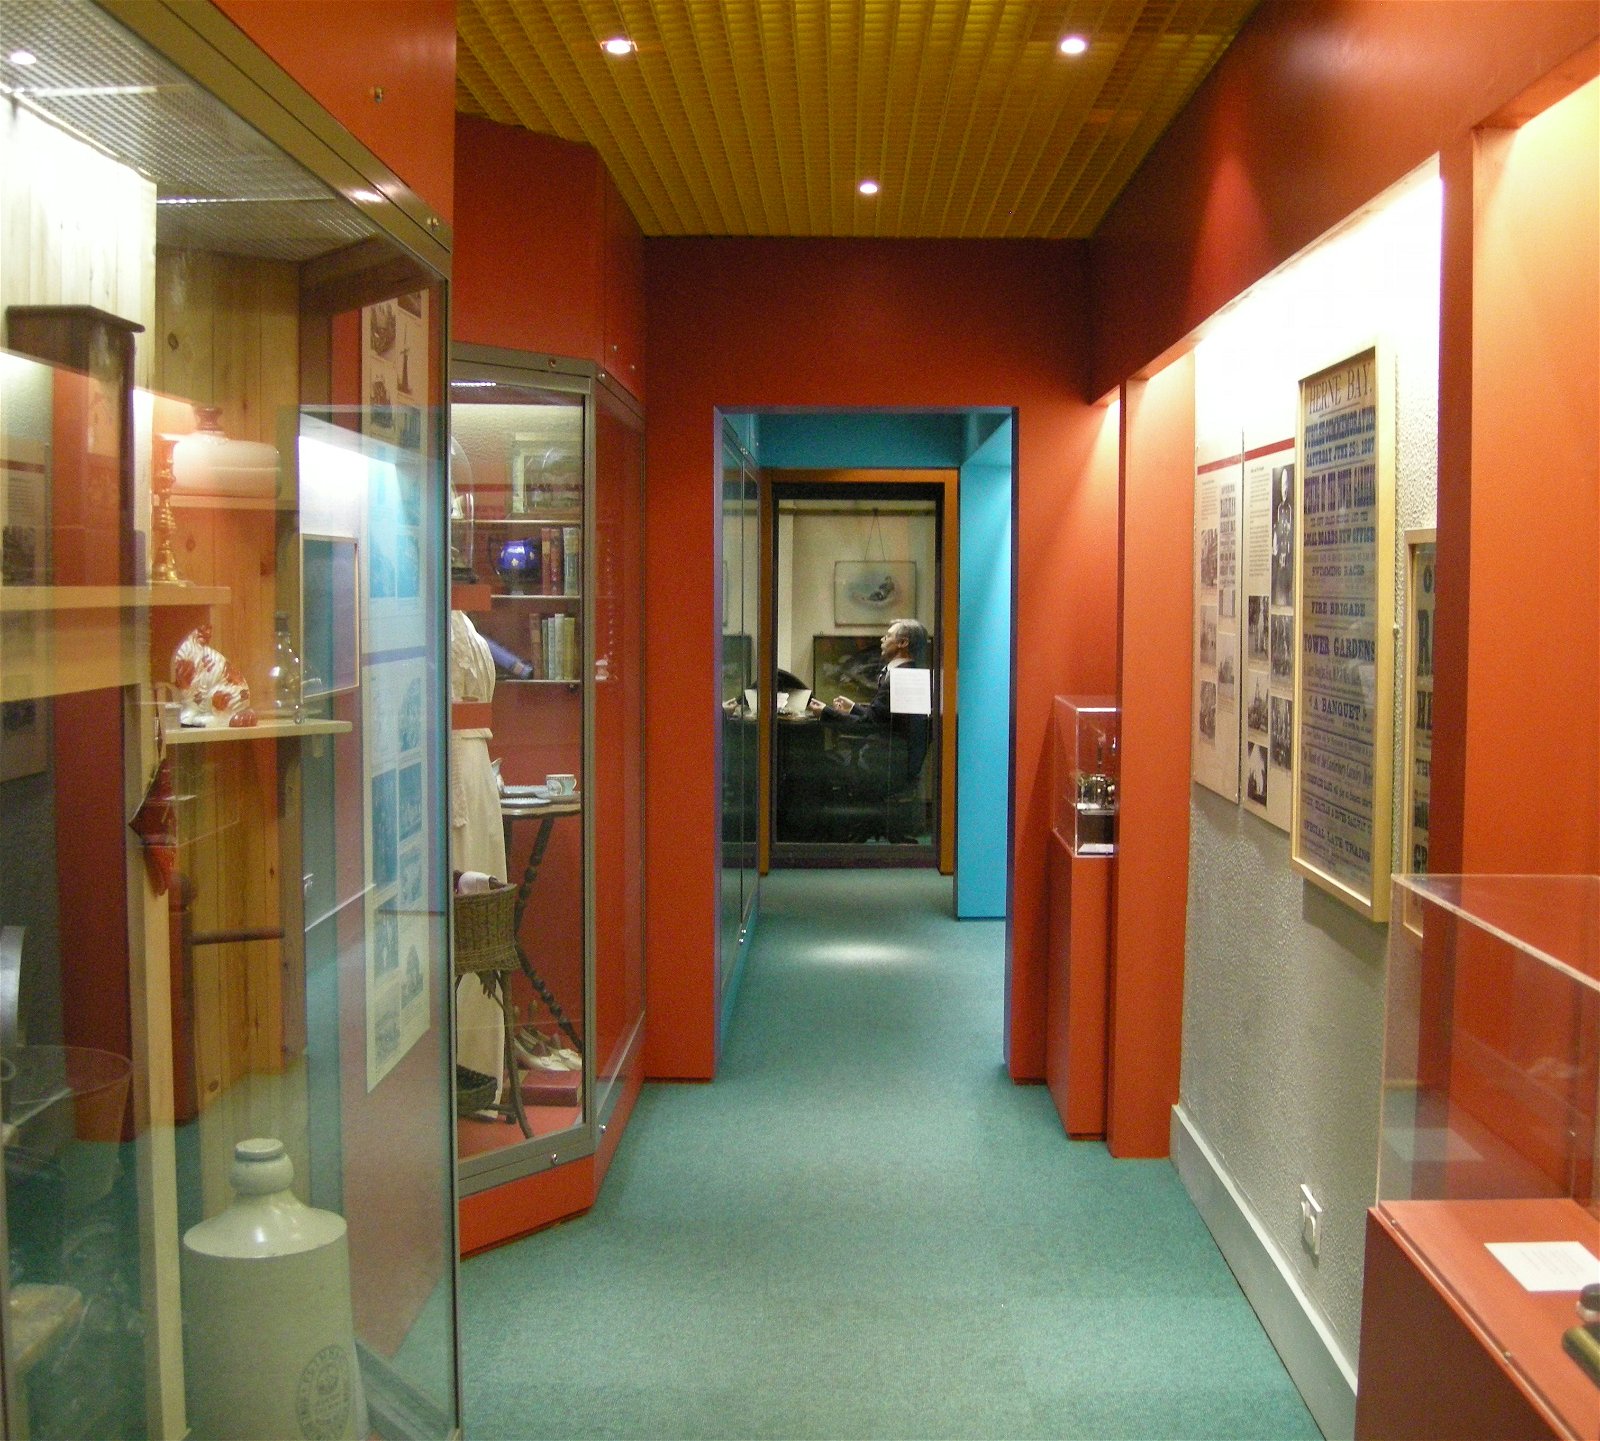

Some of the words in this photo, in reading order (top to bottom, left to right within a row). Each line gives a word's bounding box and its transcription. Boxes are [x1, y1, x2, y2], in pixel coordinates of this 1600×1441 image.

[1309, 374, 1341, 415] HERNE
[1311, 601, 1327, 615] FIRE
[1330, 602, 1365, 617] BRIGADE
[1304, 633, 1329, 655] TOWER
[1333, 636, 1375, 661] GARDENS
[1313, 696, 1319, 711] A
[1322, 697, 1360, 722] BANQUET
